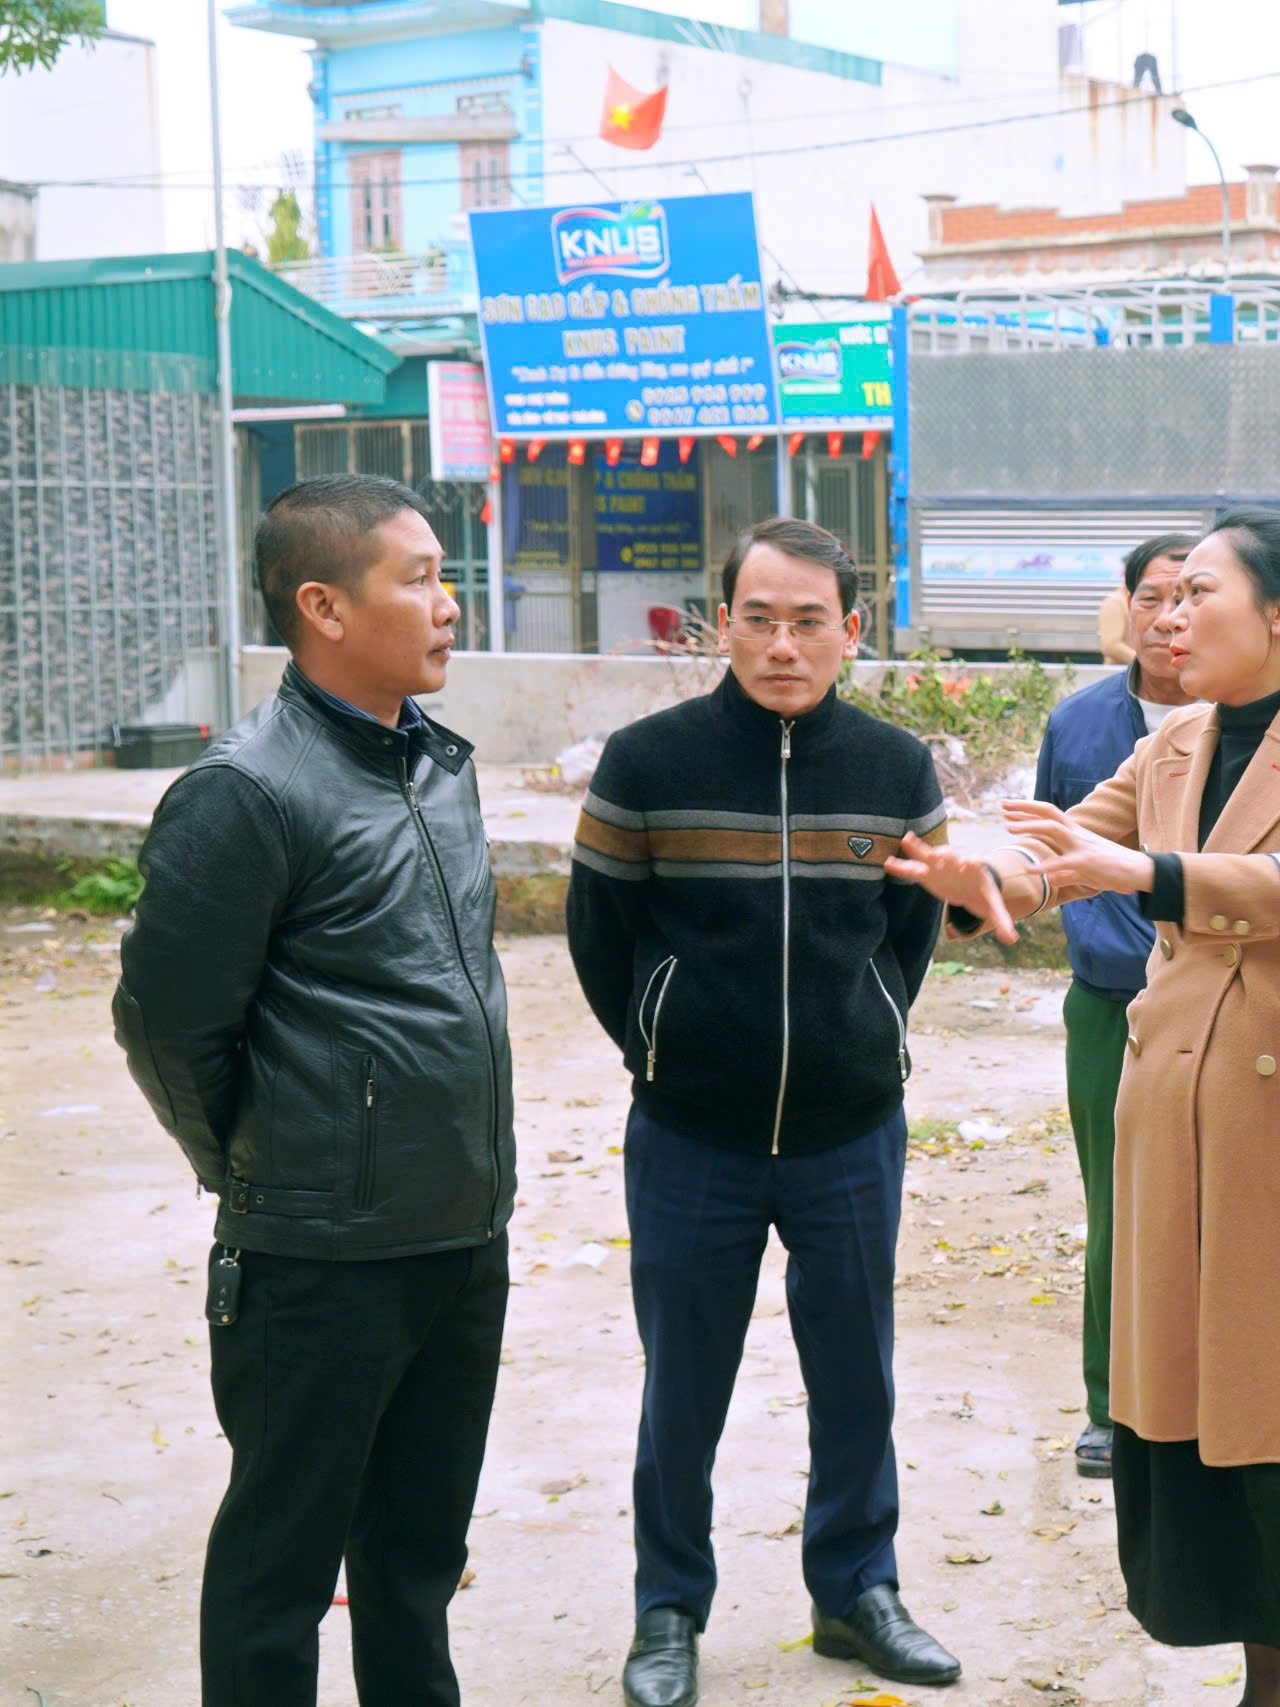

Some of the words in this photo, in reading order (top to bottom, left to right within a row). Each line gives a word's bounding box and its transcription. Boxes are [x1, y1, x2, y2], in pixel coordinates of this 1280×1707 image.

[561, 225, 661, 262] KNUS
[563, 329, 618, 357] KNUS
[625, 325, 685, 355] PAINT
